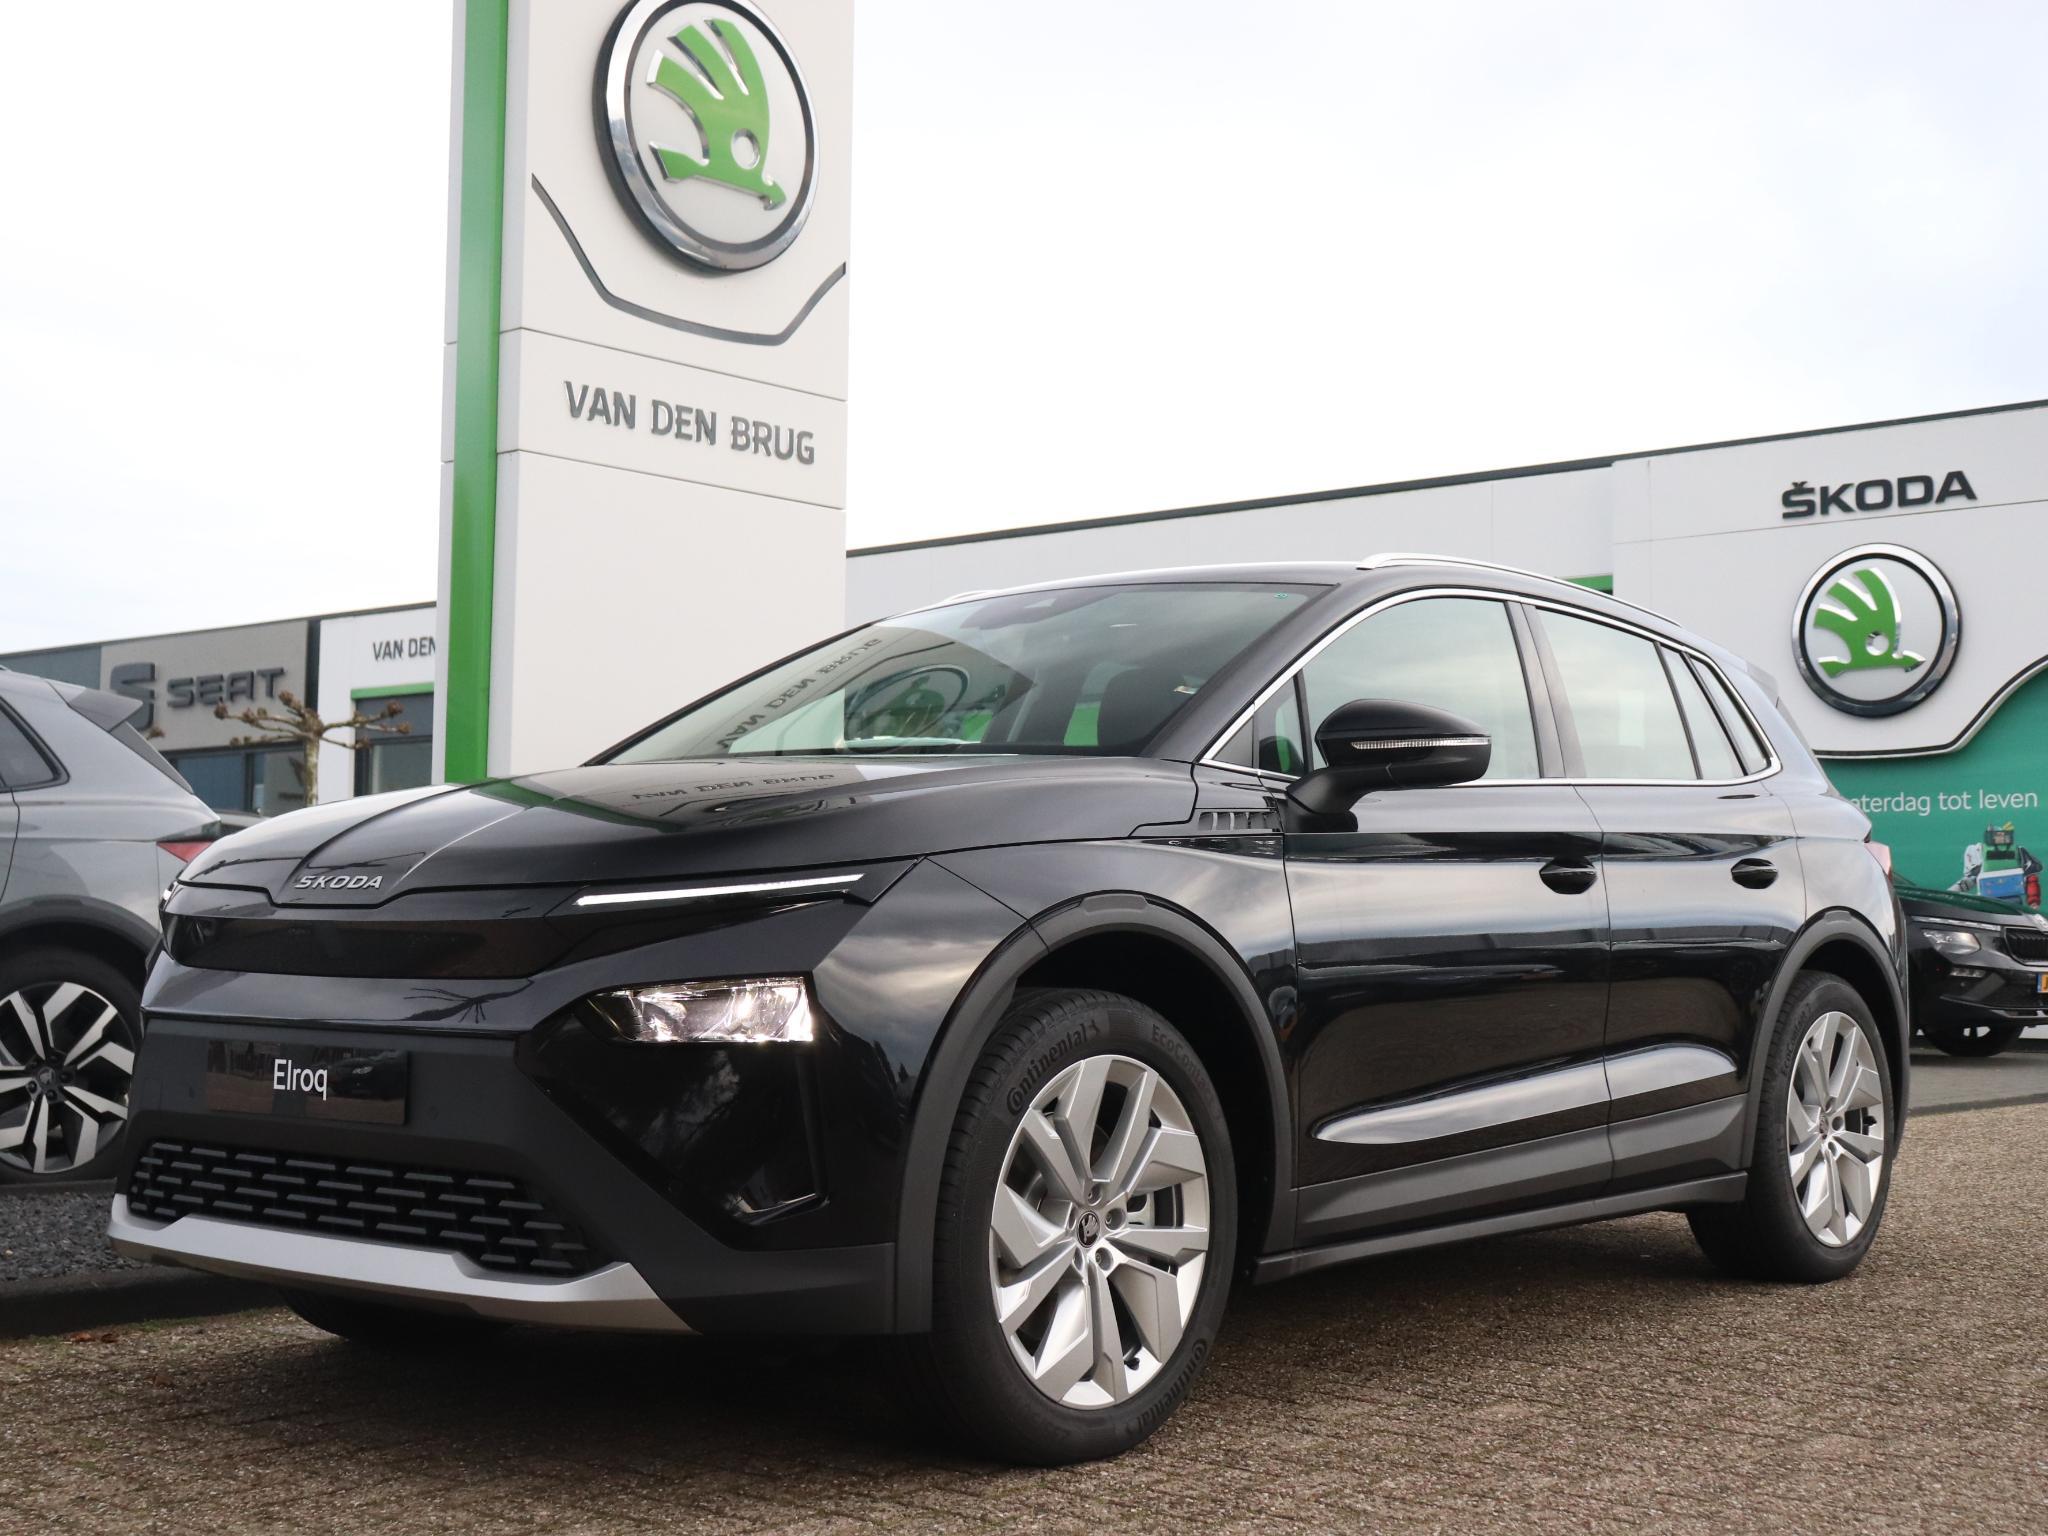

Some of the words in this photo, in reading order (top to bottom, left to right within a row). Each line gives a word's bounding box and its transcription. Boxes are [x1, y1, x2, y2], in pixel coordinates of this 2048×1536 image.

[564, 380, 636, 429] VAN
[651, 399, 717, 446] DEN
[731, 416, 815, 465] BRUG
[1781, 470, 1978, 519] ŠKODA
[373, 640, 404, 661] VAN
[408, 636, 436, 658] DEN
[167, 667, 285, 708] SEAT
[1938, 792, 1971, 811] tot
[1979, 789, 2038, 809] leven
[273, 1058, 328, 1101] Elroq
[1006, 1022, 1087, 1116] Continental
